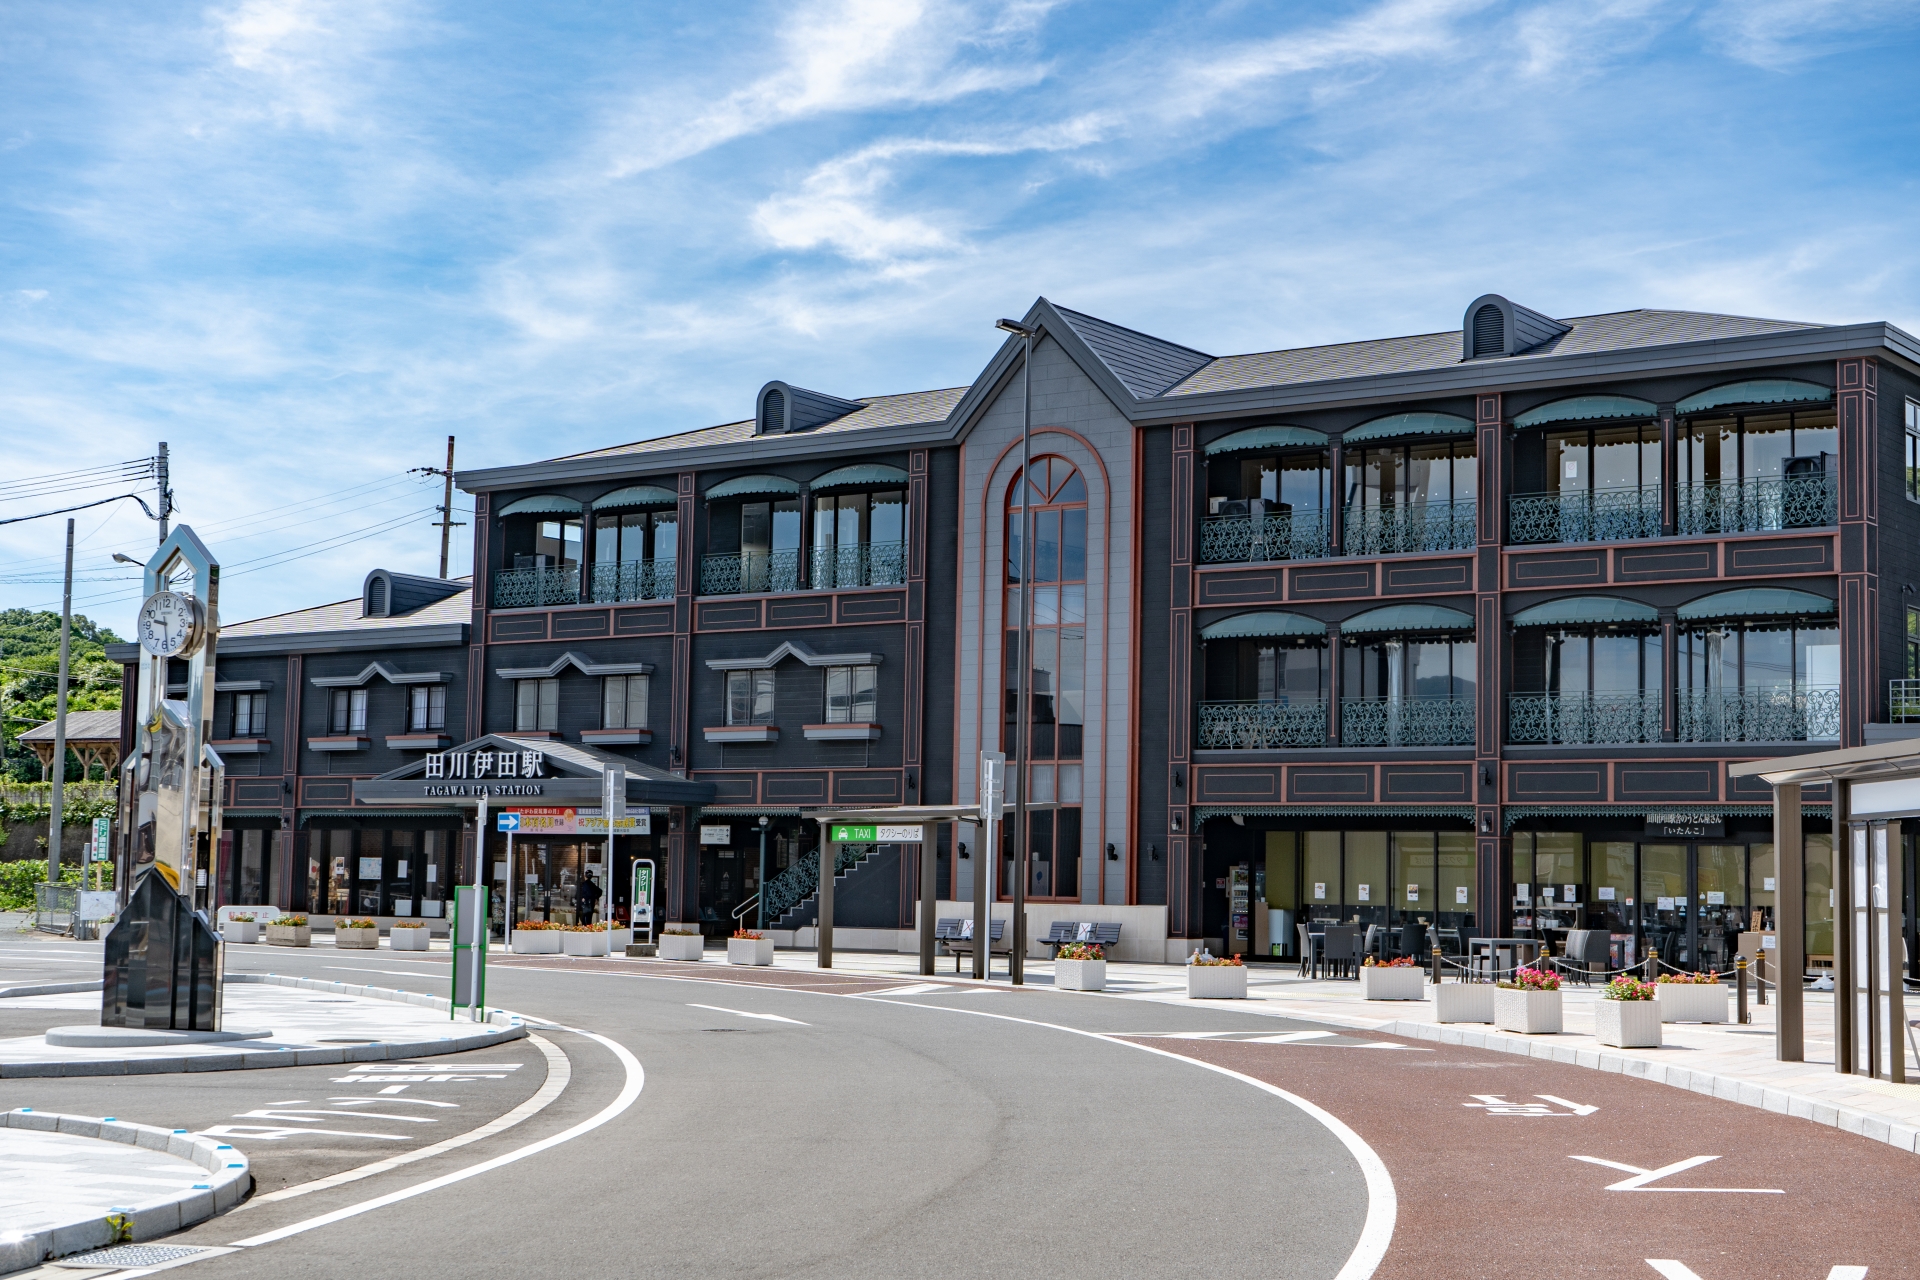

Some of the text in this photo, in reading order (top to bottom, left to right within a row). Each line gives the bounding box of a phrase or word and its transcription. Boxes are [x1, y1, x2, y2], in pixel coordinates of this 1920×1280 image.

[155, 600, 162, 610] 11
[163, 599, 171, 608] 12
[147, 610, 156, 619] 10
[178, 608, 183, 616] 2
[146, 621, 151, 630] 9
[180, 619, 185, 627] 3
[148, 630, 153, 639] 8
[177, 629, 182, 638] 4
[154, 639, 160, 647] 7
[162, 640, 167, 649] 6
[170, 637, 176, 646] 5
[425, 751, 544, 779] 田川伊田駅
[424, 785, 541, 796] TAGAWA ITA STATION
[854, 828, 871, 839] TAXI
[880, 828, 920, 839] タクシーのりば
